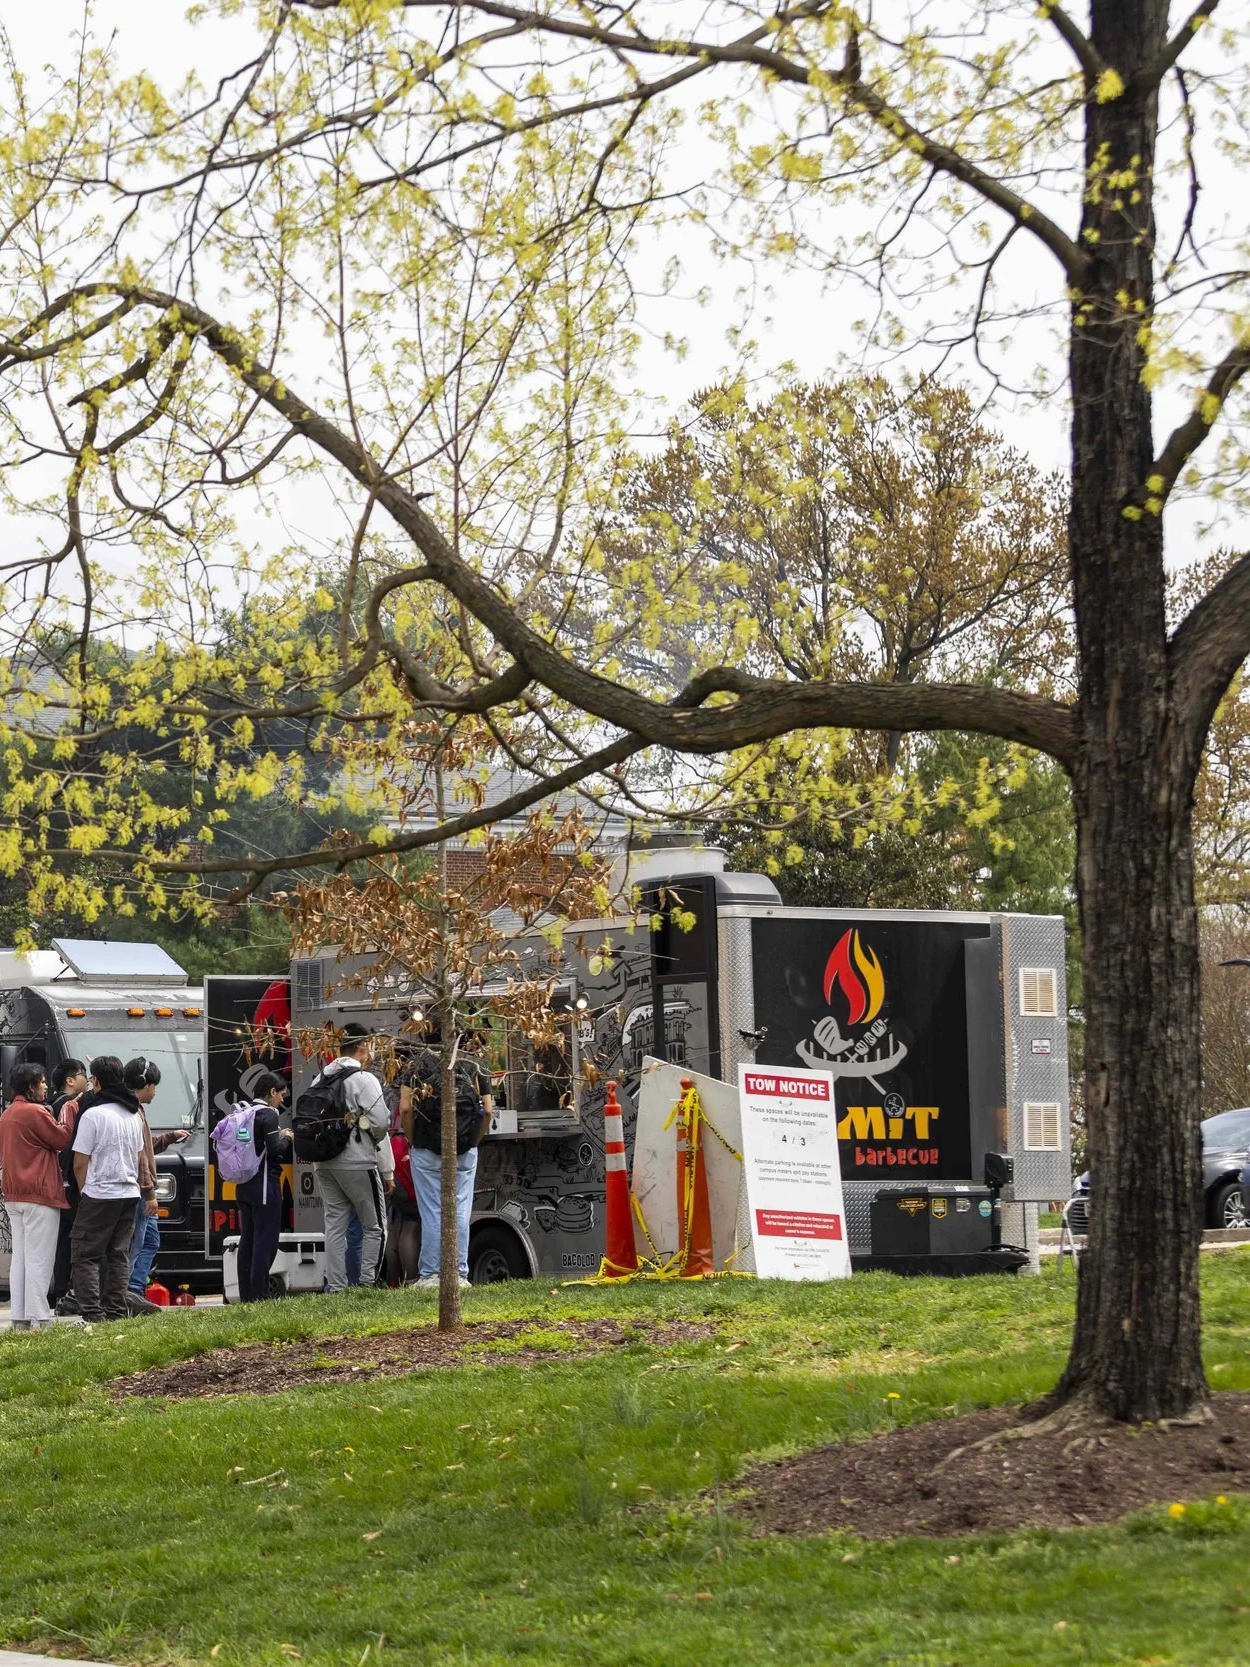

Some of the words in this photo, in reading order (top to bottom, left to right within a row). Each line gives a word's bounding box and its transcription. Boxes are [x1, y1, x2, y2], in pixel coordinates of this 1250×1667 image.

[747, 1078, 776, 1091] TOW
[779, 1080, 826, 1096] NOTICE
[782, 1134, 788, 1143] 4
[800, 1138, 806, 1146] 3
[562, 1254, 595, 1267] BACOLOD
